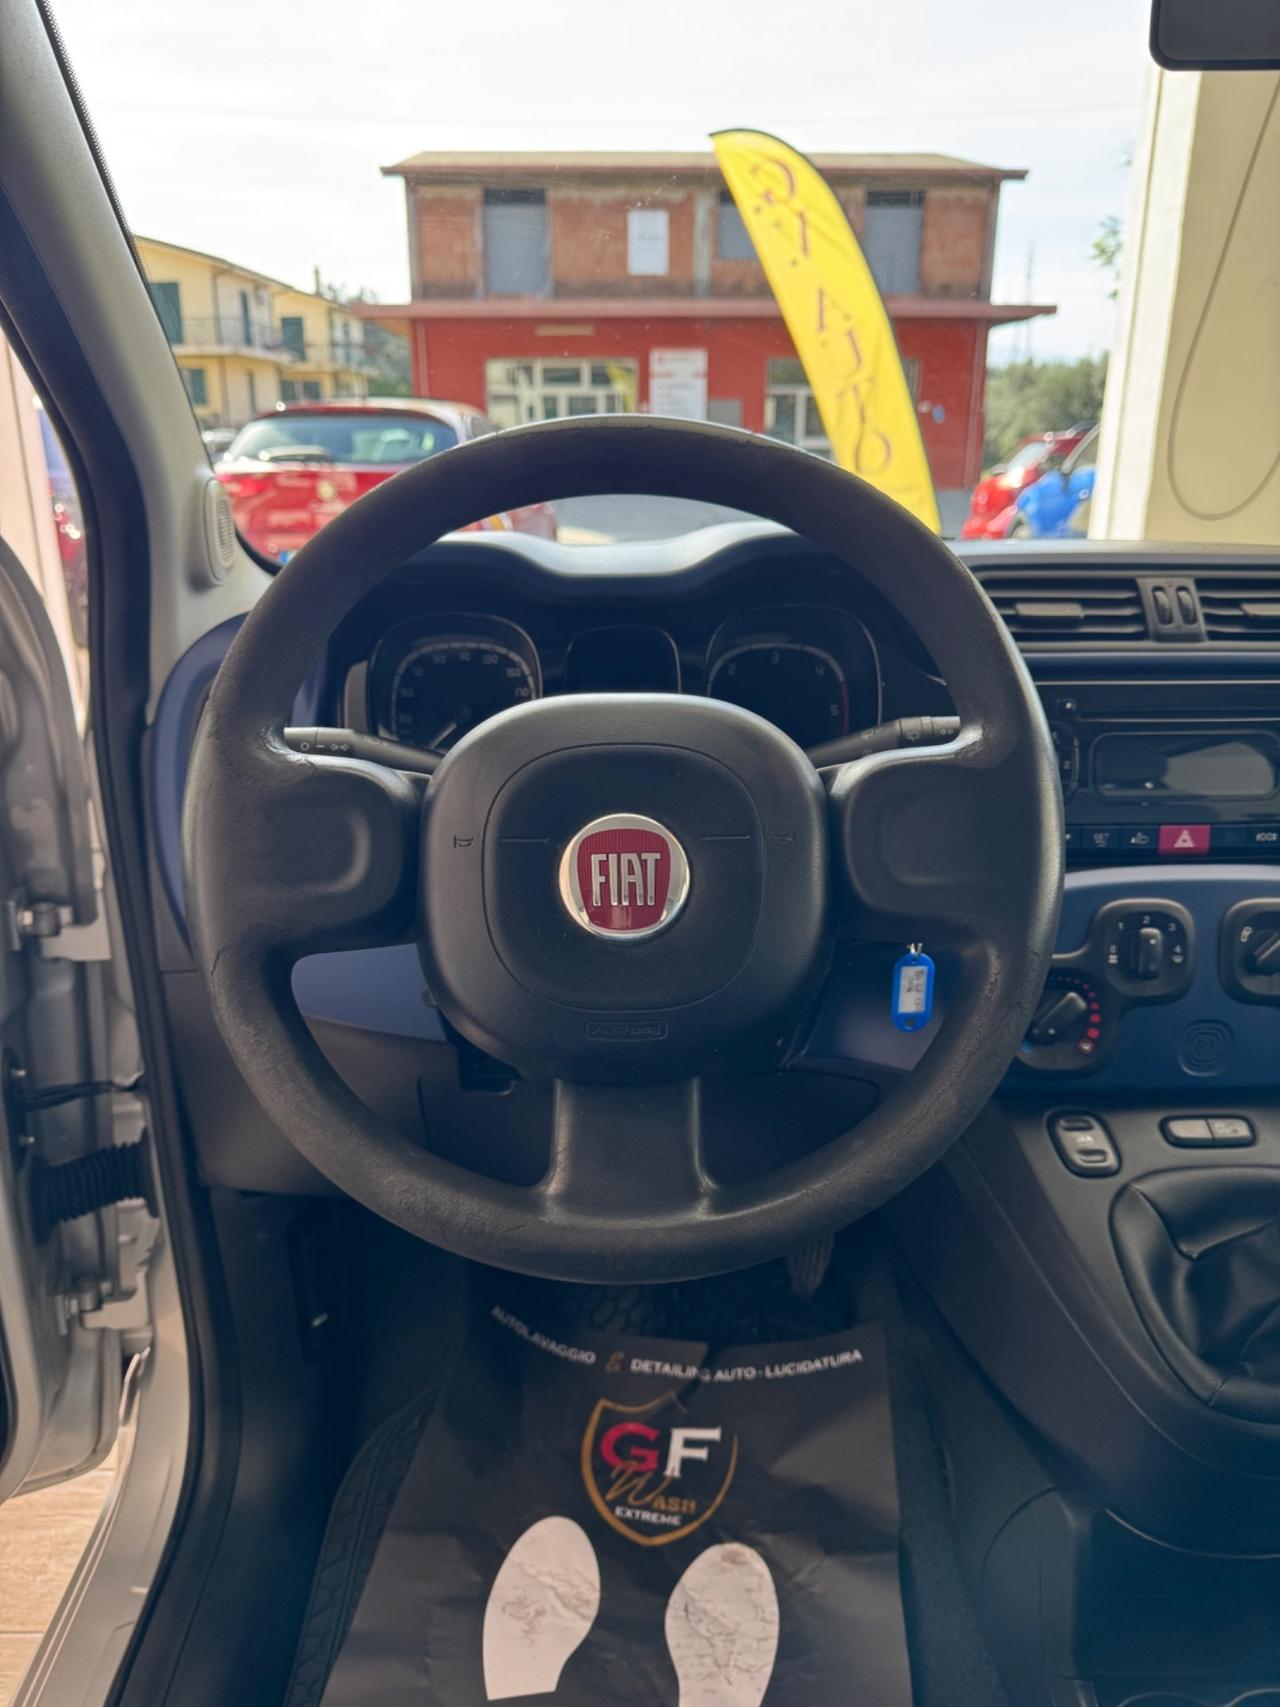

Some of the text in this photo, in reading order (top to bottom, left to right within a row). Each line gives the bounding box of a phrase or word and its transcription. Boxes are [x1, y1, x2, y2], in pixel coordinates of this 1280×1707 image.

[771, 652, 781, 665] 3
[728, 663, 736, 675] 2
[815, 665, 825, 677] 4
[830, 704, 839, 716] 5
[591, 852, 661, 906] FIAT
[1142, 915, 1151, 925] 2
[1168, 922, 1176, 931] 3
[1109, 945, 1117, 954] 0
[1173, 945, 1181, 954] 4
[491, 1305, 598, 1365] AUTOLAVAGGIO
[605, 1351, 624, 1372] &
[712, 1366, 757, 1383] AUTO
[764, 1348, 864, 1380] LUCIDATURA
[614, 1505, 683, 1526] EXTREME
